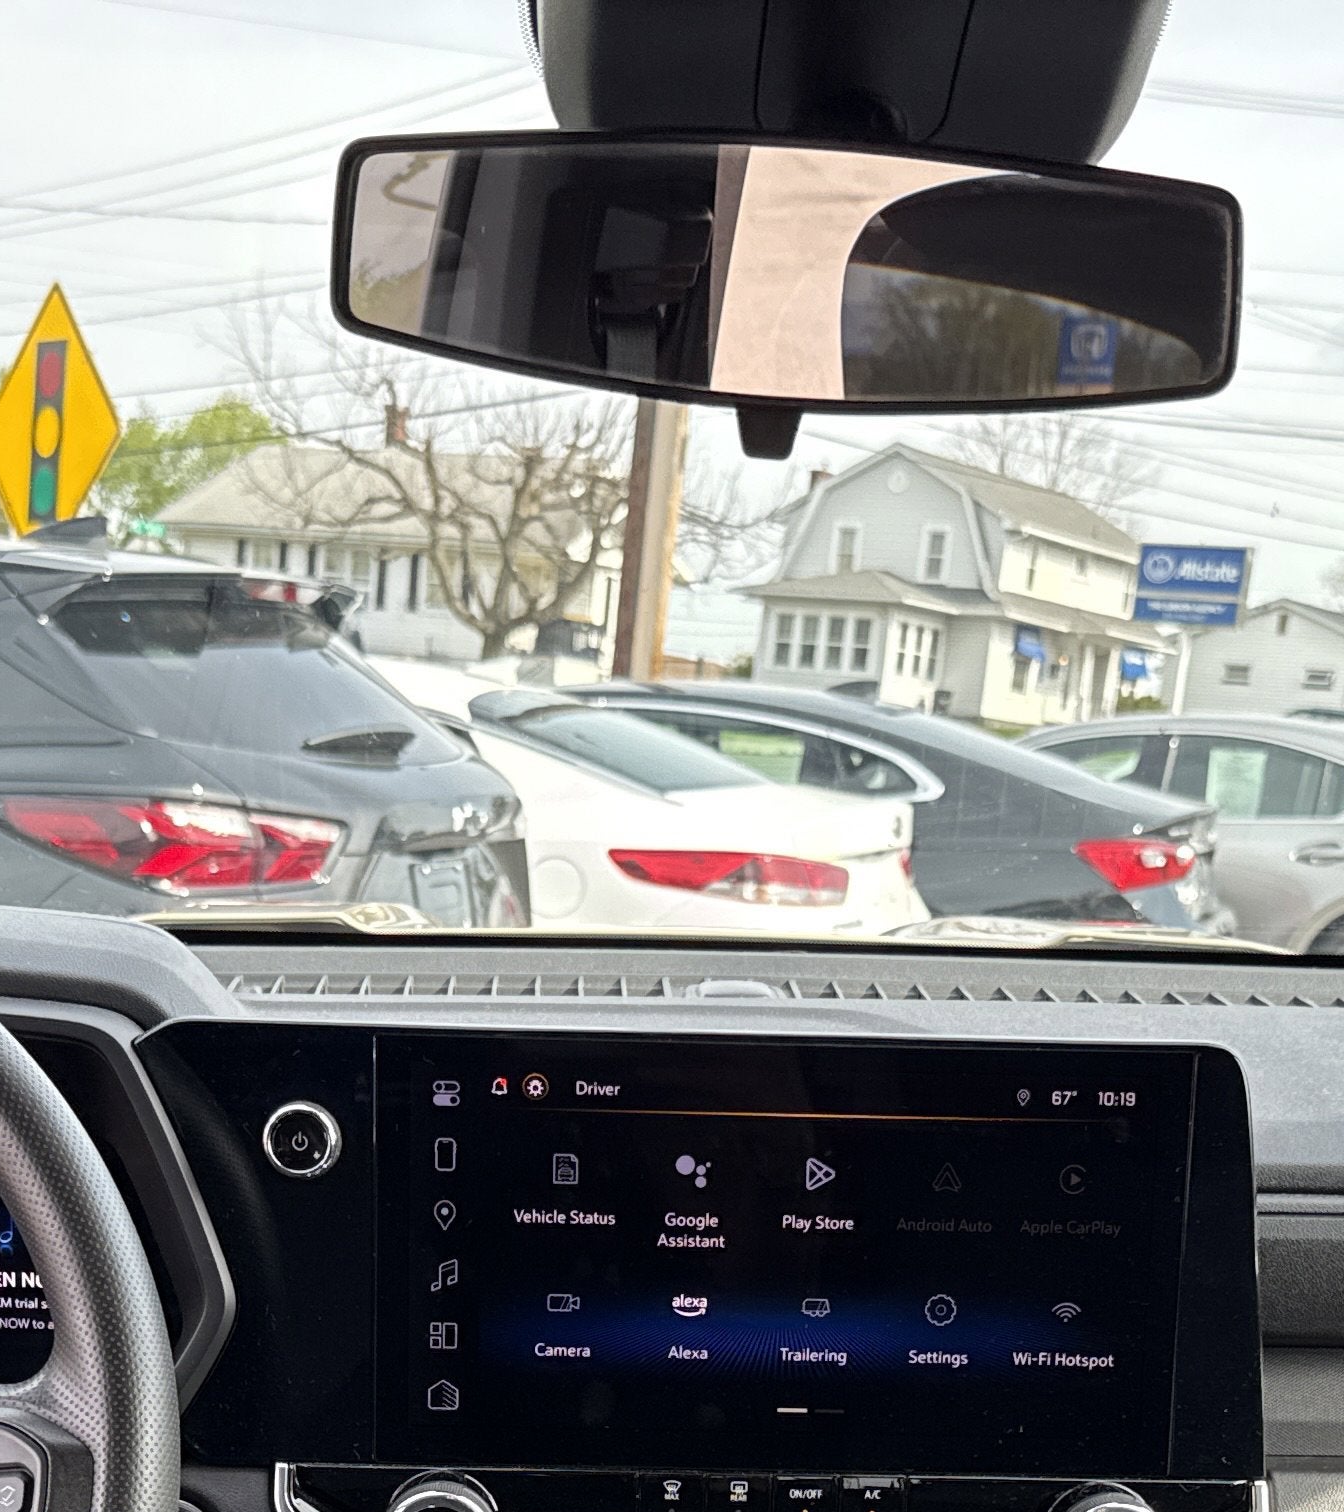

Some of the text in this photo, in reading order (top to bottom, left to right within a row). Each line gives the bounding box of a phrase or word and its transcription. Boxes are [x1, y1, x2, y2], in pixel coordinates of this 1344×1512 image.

[575, 1080, 620, 1096] Driver
[1097, 1091, 1136, 1107] 10:19
[514, 1209, 616, 1226] Vehicle Status
[664, 1212, 719, 1230] Google
[782, 1215, 854, 1232] Play Store
[896, 1218, 992, 1233] Android Auto
[1020, 1221, 1121, 1238] Apple CarPlay
[657, 1233, 725, 1249] Assistant
[14, 1298, 38, 1309] trial
[671, 1294, 708, 1308] alexa
[32, 1319, 45, 1329] to
[534, 1343, 591, 1358] Camera
[668, 1346, 709, 1360] Alexa
[780, 1348, 847, 1367] Trailering
[908, 1351, 969, 1367] Settings
[1013, 1352, 1115, 1369] Wi-Fi Hotspot
[789, 1488, 823, 1500] ON/OFF
[864, 1489, 882, 1500] A/C
